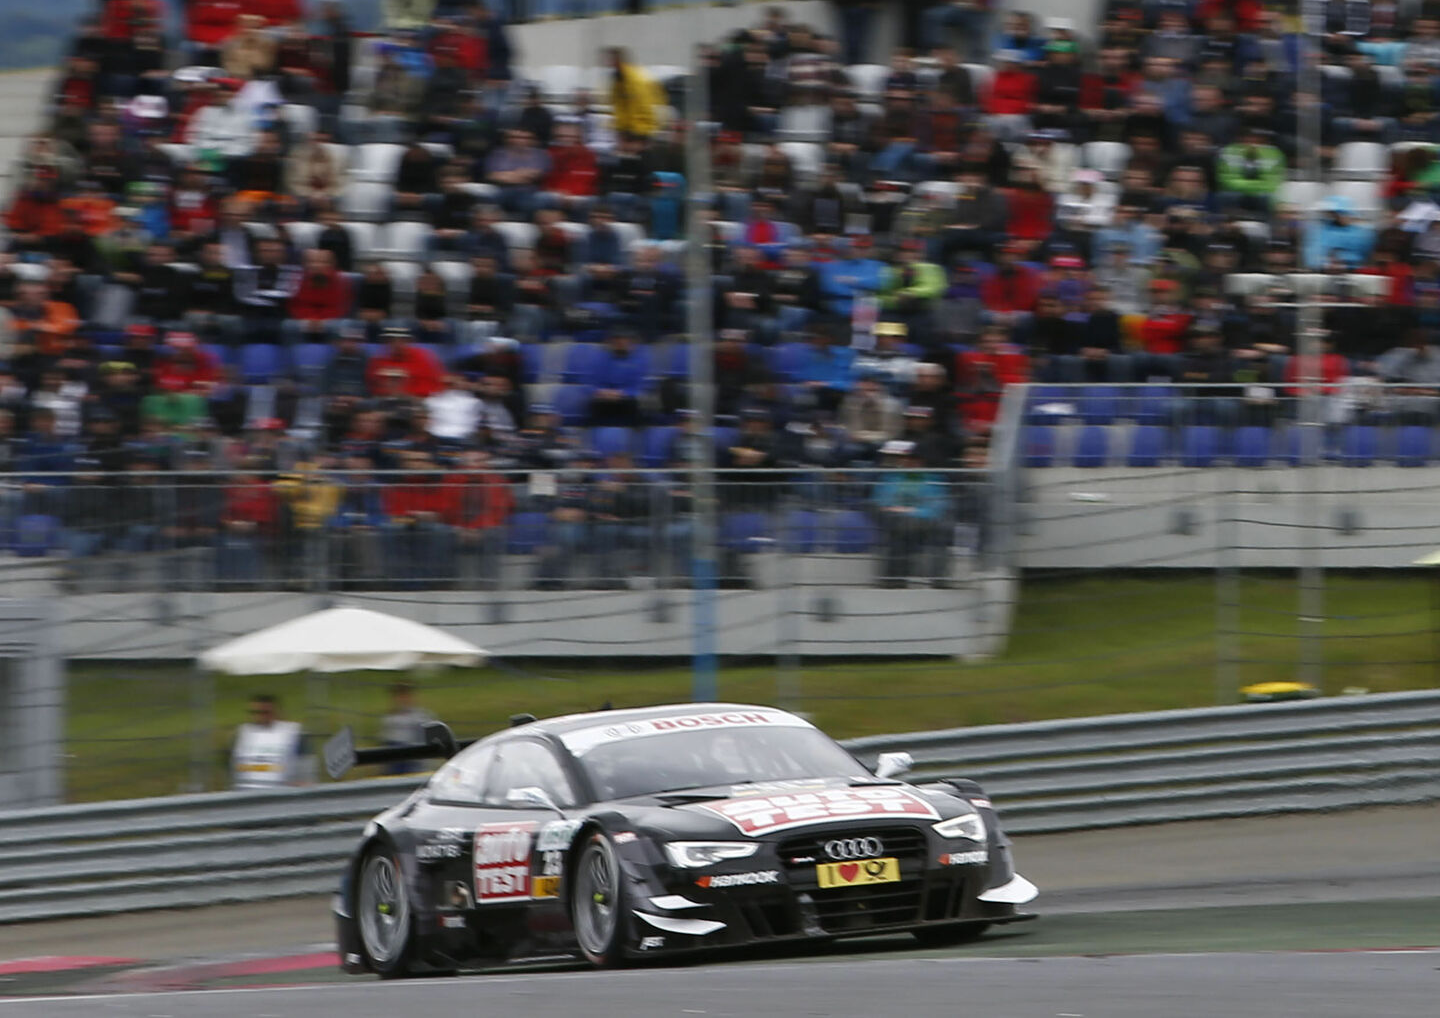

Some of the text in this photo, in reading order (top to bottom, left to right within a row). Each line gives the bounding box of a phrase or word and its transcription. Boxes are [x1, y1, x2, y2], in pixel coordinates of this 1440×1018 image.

[651, 714, 770, 730] BOSCH
[735, 799, 913, 826] TEST
[475, 866, 529, 894] TEST
